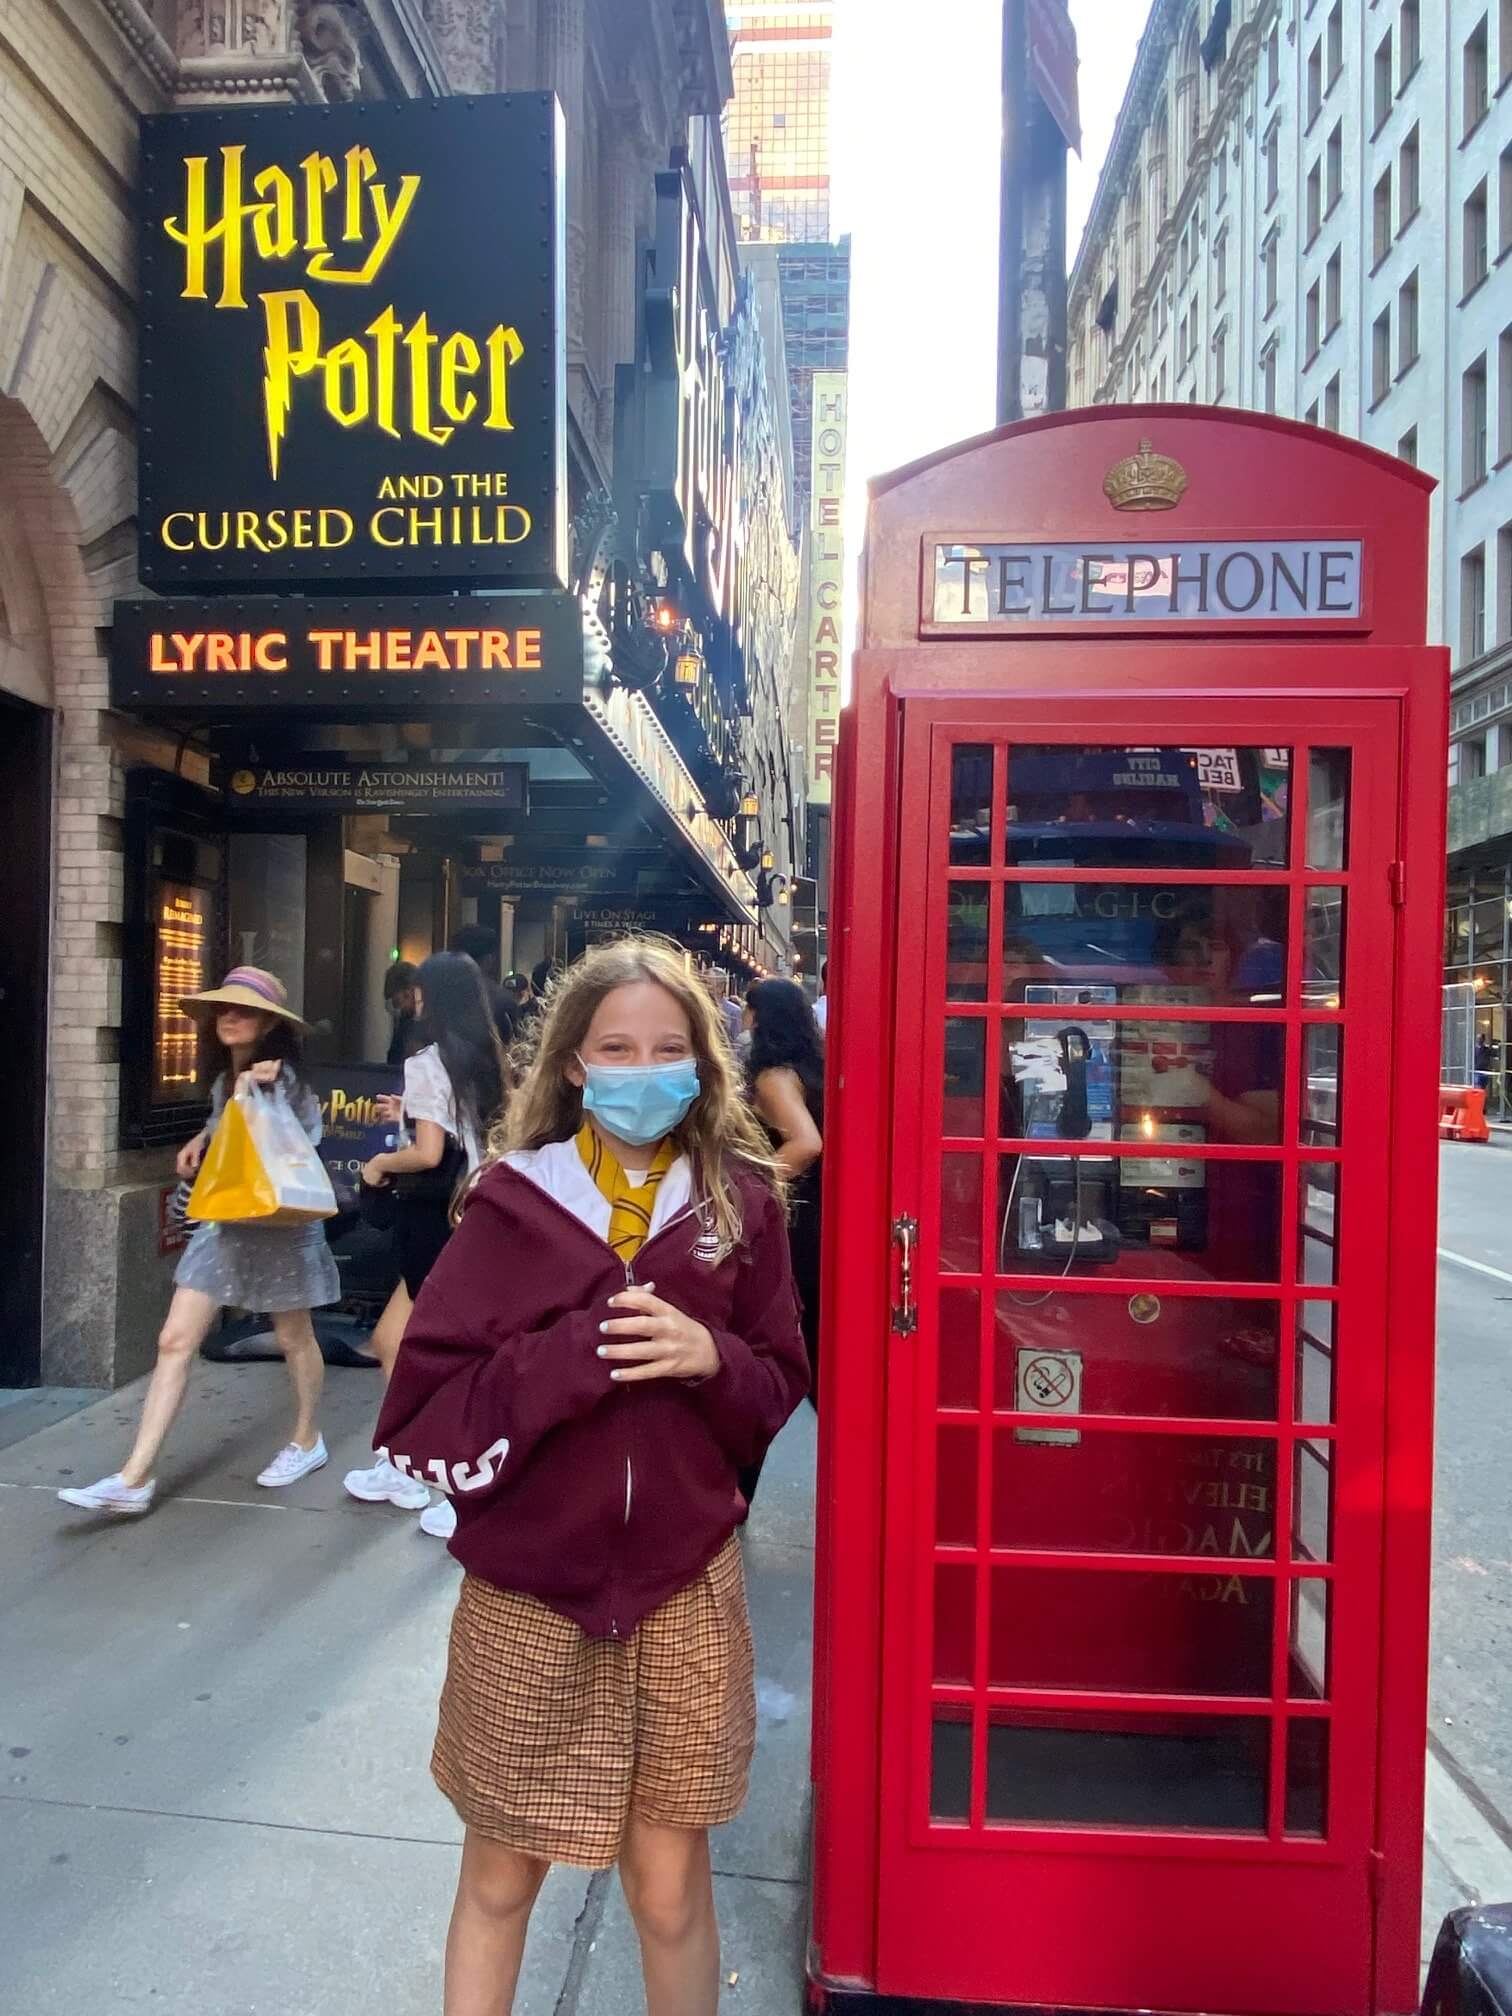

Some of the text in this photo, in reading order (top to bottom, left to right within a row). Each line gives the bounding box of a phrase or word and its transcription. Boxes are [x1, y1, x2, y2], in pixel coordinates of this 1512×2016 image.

[163, 144, 421, 309] Harry
[258, 289, 525, 481] Potter
[377, 473, 508, 499] AND THE
[161, 505, 532, 552] CURSED CHILD
[814, 393, 843, 781] HOTEL CARTER
[943, 551, 1354, 615] TELEPHONE
[150, 629, 542, 671] LYRIC THEATRE
[262, 769, 504, 787] ABSOLUTE ASTONISHMENT!
[573, 907, 656, 921] LIVE ON STAGE
[331, 1088, 384, 1127] Potte
